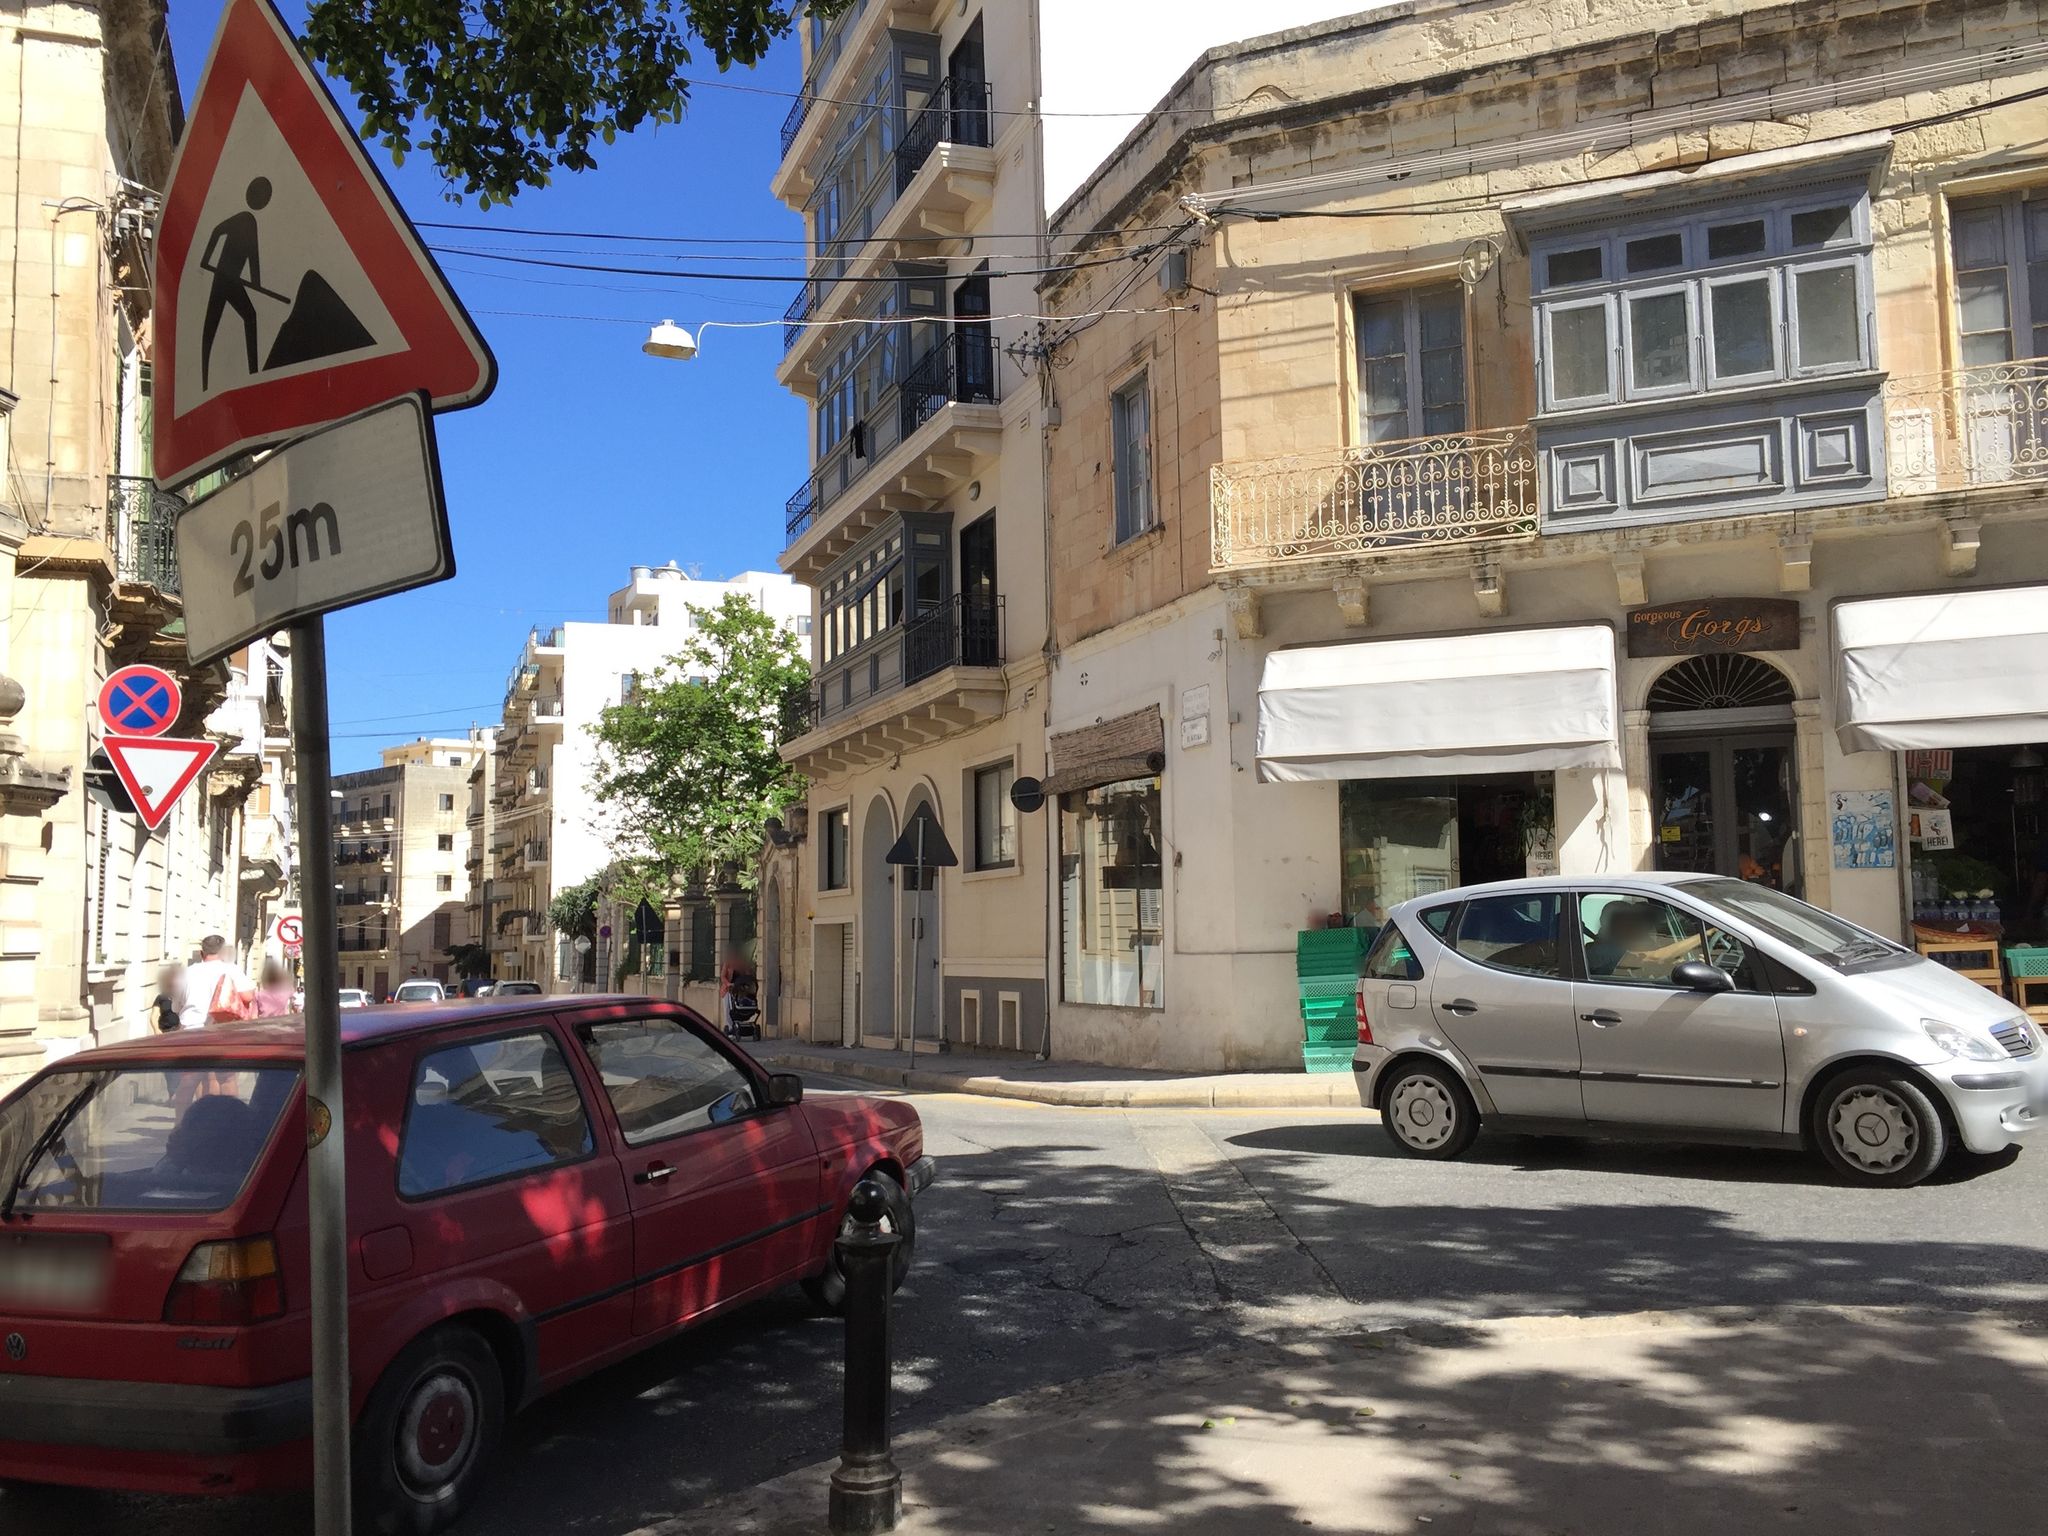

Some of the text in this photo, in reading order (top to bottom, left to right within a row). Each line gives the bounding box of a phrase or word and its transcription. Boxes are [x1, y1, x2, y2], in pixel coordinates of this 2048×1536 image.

[230, 501, 341, 598] 25m
[1633, 610, 1682, 626] Gorgeous
[1670, 608, 1768, 649] Gorgs
[1926, 836, 1948, 846] HERE!
